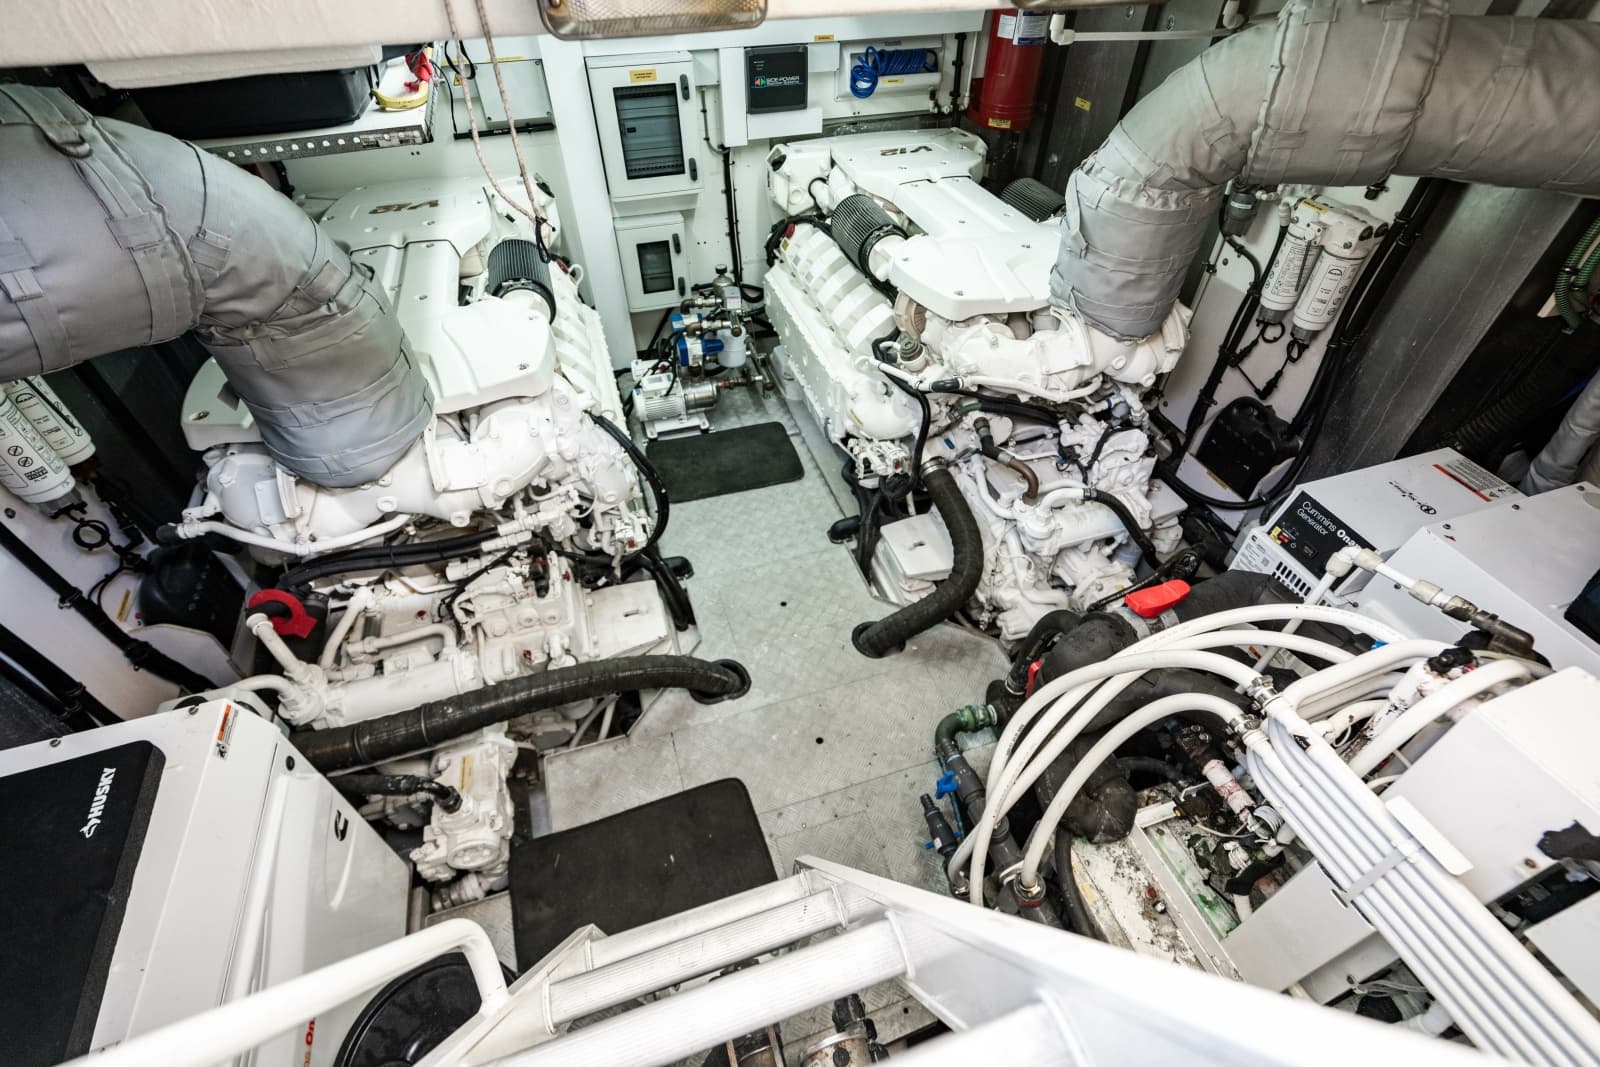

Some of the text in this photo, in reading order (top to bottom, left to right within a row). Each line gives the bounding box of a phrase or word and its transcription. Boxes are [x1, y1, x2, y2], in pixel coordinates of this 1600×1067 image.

[1297, 508, 1329, 536] Generator
[1302, 501, 1359, 548] Cummins Ona
[87, 767, 116, 819] HUSKY
